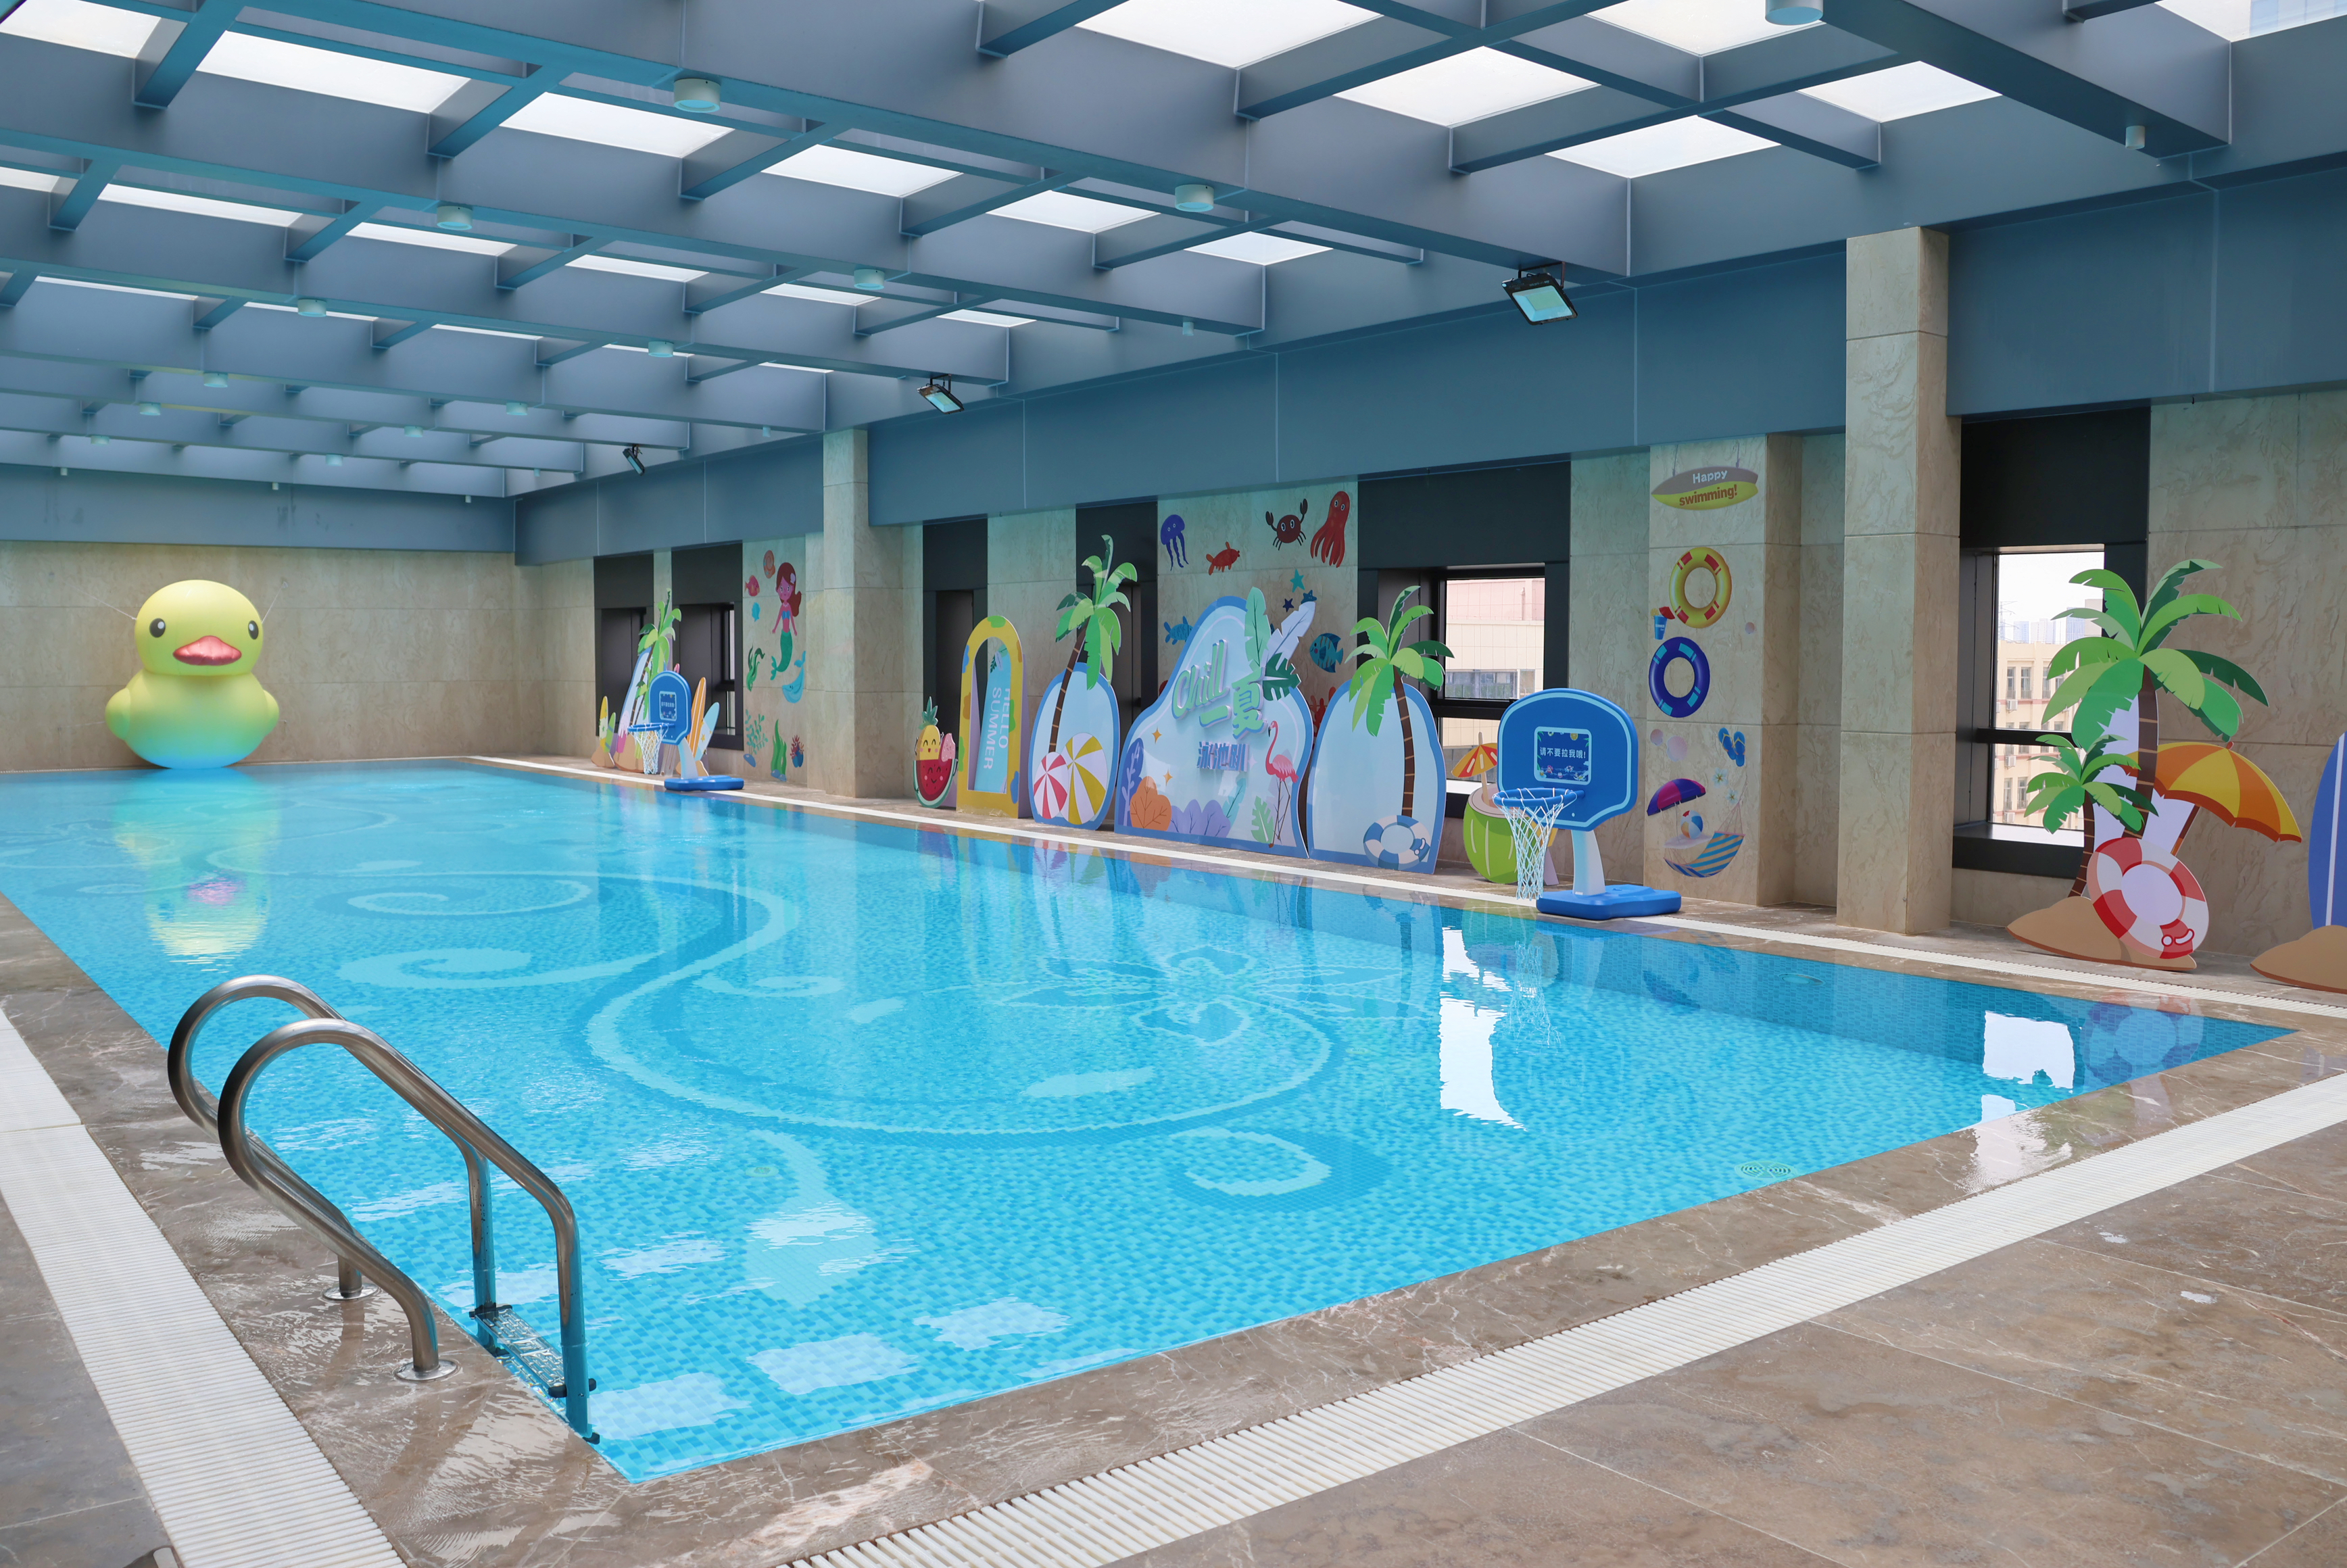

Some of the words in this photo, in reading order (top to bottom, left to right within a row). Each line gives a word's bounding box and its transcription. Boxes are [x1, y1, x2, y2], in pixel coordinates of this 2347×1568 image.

[1679, 484, 1737, 506] swimming!
[1693, 470, 1728, 484] Happy
[1171, 639, 1230, 720] Chill
[1199, 667, 1268, 741] 一夏
[984, 687, 1002, 769] SUMMER
